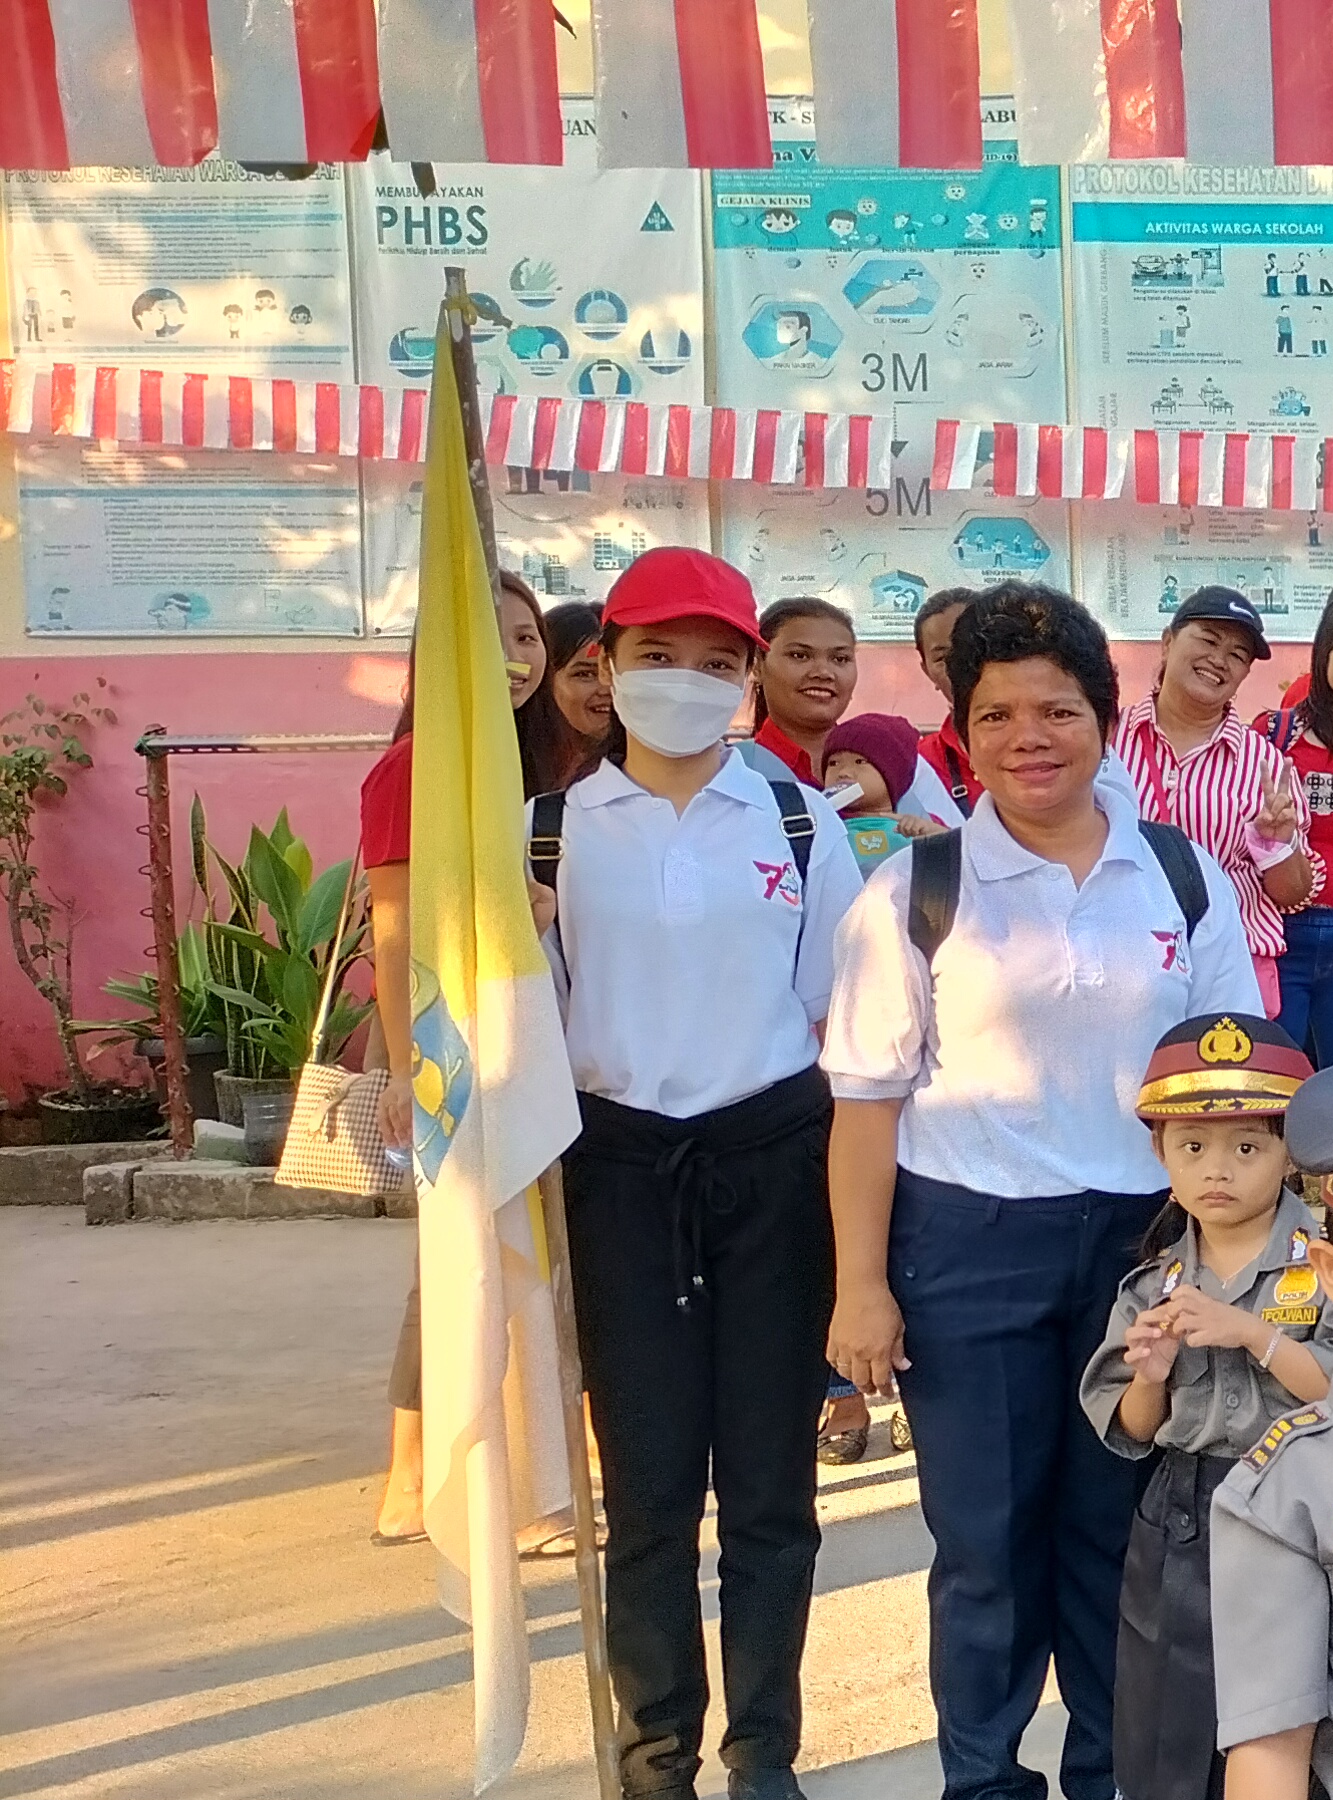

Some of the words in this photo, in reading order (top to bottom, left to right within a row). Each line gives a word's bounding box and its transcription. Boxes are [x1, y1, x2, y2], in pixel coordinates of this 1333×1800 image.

[1072, 164, 1180, 194] PROTOKOL
[1183, 164, 1301, 195] KESEHATAN
[375, 186, 484, 198] MEMBUAYAKAN
[720, 197, 766, 206] GEJALA
[769, 197, 810, 206] KLINIS
[376, 205, 488, 246] PHBS
[1145, 222, 1208, 235] AKTIVITAS
[1211, 222, 1262, 236] WARGA
[1265, 222, 1324, 236] SEKOLAH
[861, 352, 928, 392] 3M
[865, 477, 932, 517] 5M
[1265, 1308, 1312, 1321] POLWAN
